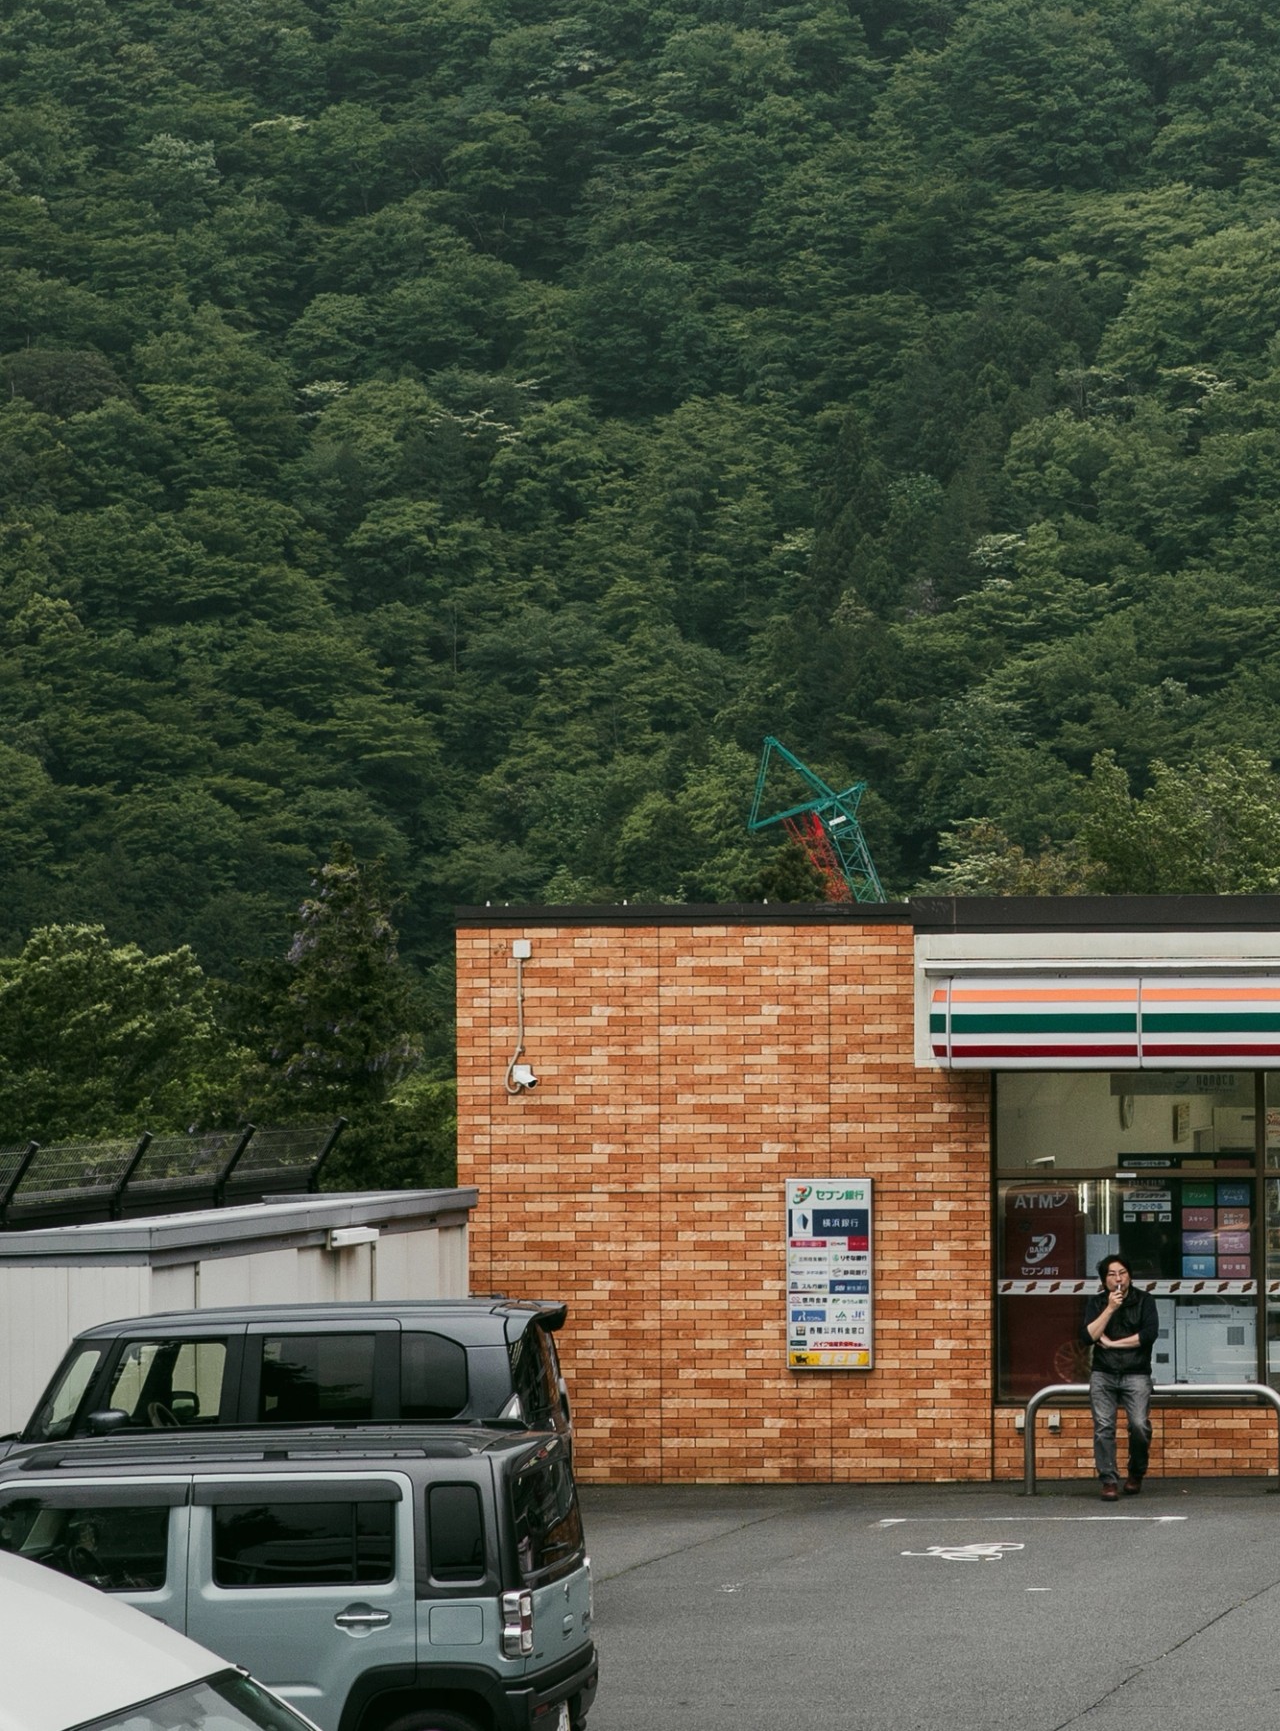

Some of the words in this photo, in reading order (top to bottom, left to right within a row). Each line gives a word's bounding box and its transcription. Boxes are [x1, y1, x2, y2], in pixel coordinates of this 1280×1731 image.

[816, 1190, 864, 1201] セブン銀行
[1014, 1193, 1054, 1209] ATM
[822, 1218, 859, 1228] 横浜銀行
[1021, 1266, 1059, 1276] セブン銀行
